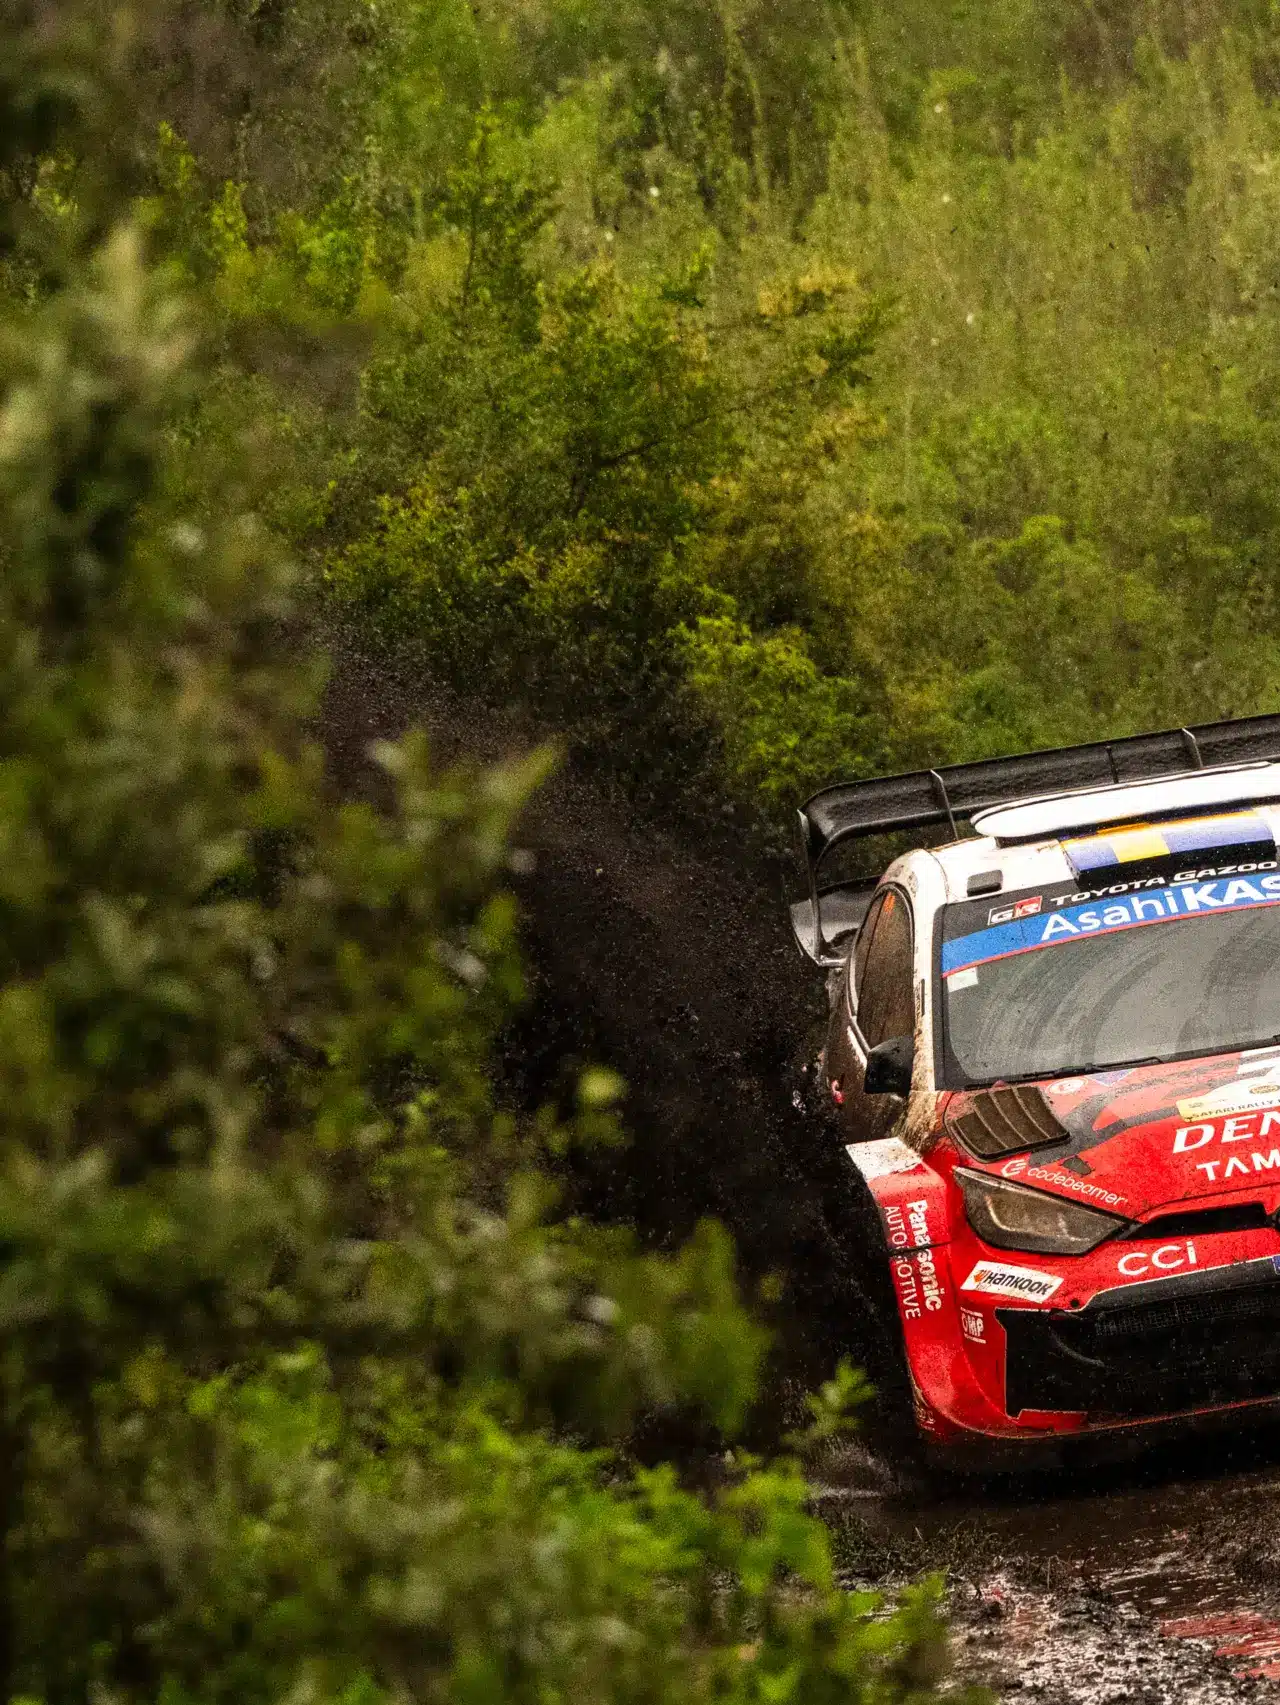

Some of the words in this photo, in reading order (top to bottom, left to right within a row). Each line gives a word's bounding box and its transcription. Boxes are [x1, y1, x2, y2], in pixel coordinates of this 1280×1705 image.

[1050, 877, 1165, 906] TOYOTA
[1170, 860, 1277, 881] GAZOO
[990, 902, 1039, 923] GR
[1192, 1106, 1235, 1118] SAFARI
[1237, 1099, 1273, 1110] RALLY
[1028, 1166, 1126, 1206] codebeamer
[906, 1199, 942, 1312] Panasonic
[962, 1312, 984, 1337] OMP
